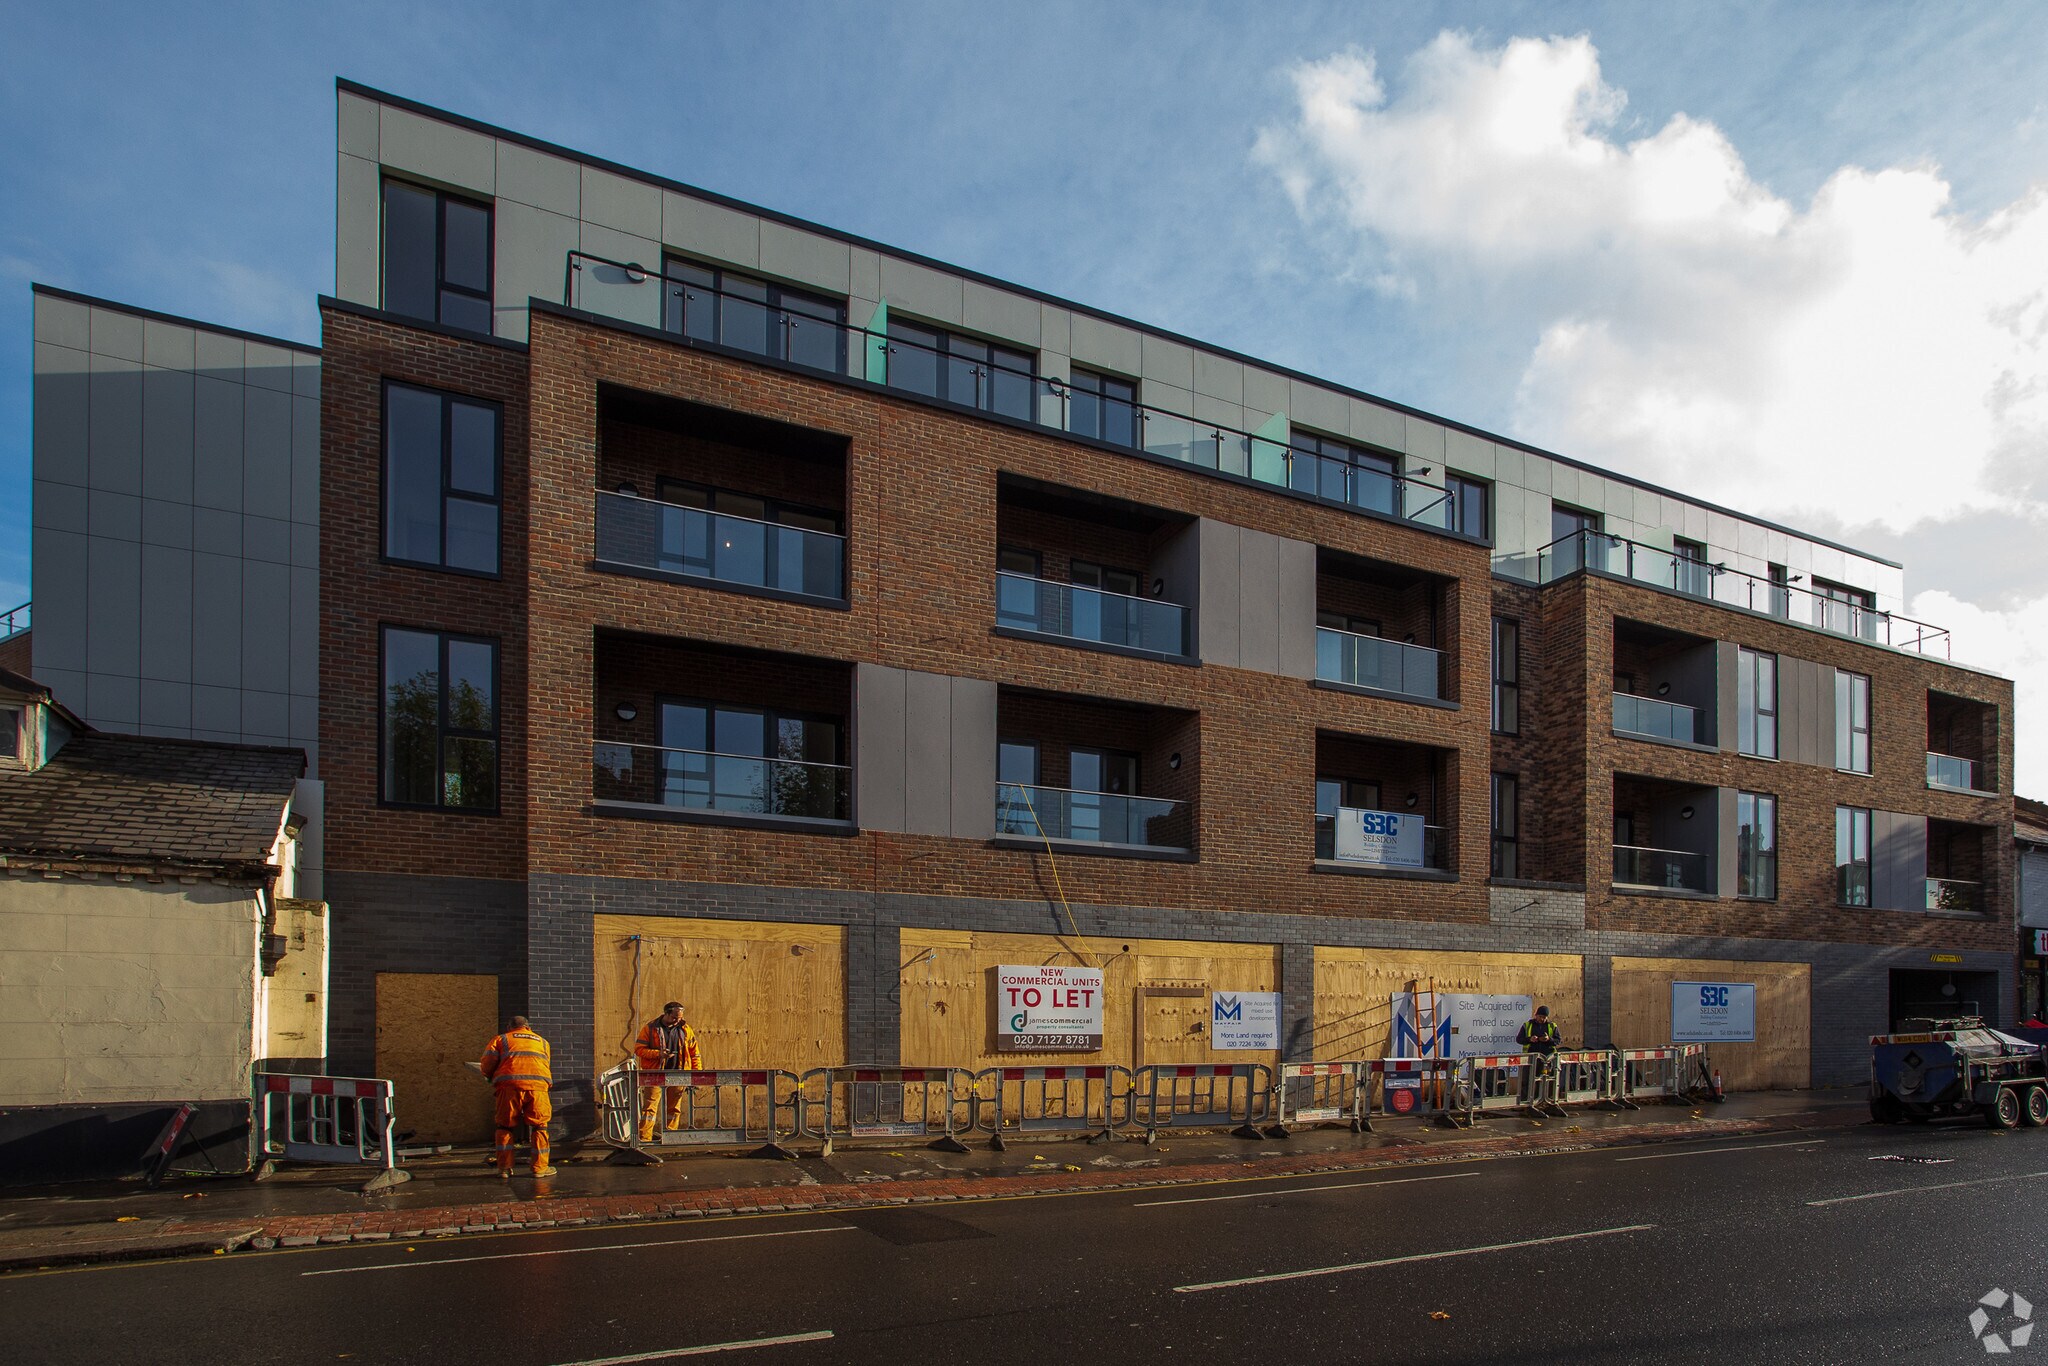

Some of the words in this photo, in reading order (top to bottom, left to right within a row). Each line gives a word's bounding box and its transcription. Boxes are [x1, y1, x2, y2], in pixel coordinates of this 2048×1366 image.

[1363, 835, 1398, 844] SELSDON
[1040, 968, 1064, 976] NEW
[1002, 976, 1068, 986] COMMERCIAL
[1072, 978, 1100, 987] UNITS
[1006, 987, 1042, 1008] TO
[1052, 988, 1095, 1008] LET
[1458, 1001, 1475, 1011] Site
[1477, 1001, 1513, 1013] Acquired
[1515, 1001, 1527, 1011] for
[1700, 1007, 1728, 1015] SELSDON
[1028, 1017, 1093, 1025] jamescommercial
[1472, 1017, 1497, 1027] mixed
[1500, 1019, 1514, 1027] use
[1014, 1035, 1034, 1045] 020
[1037, 1035, 1062, 1045] 7127
[1065, 1035, 1090, 1045] 8781
[1251, 1032, 1273, 1040] required
[1467, 1033, 1516, 1045] developmen
